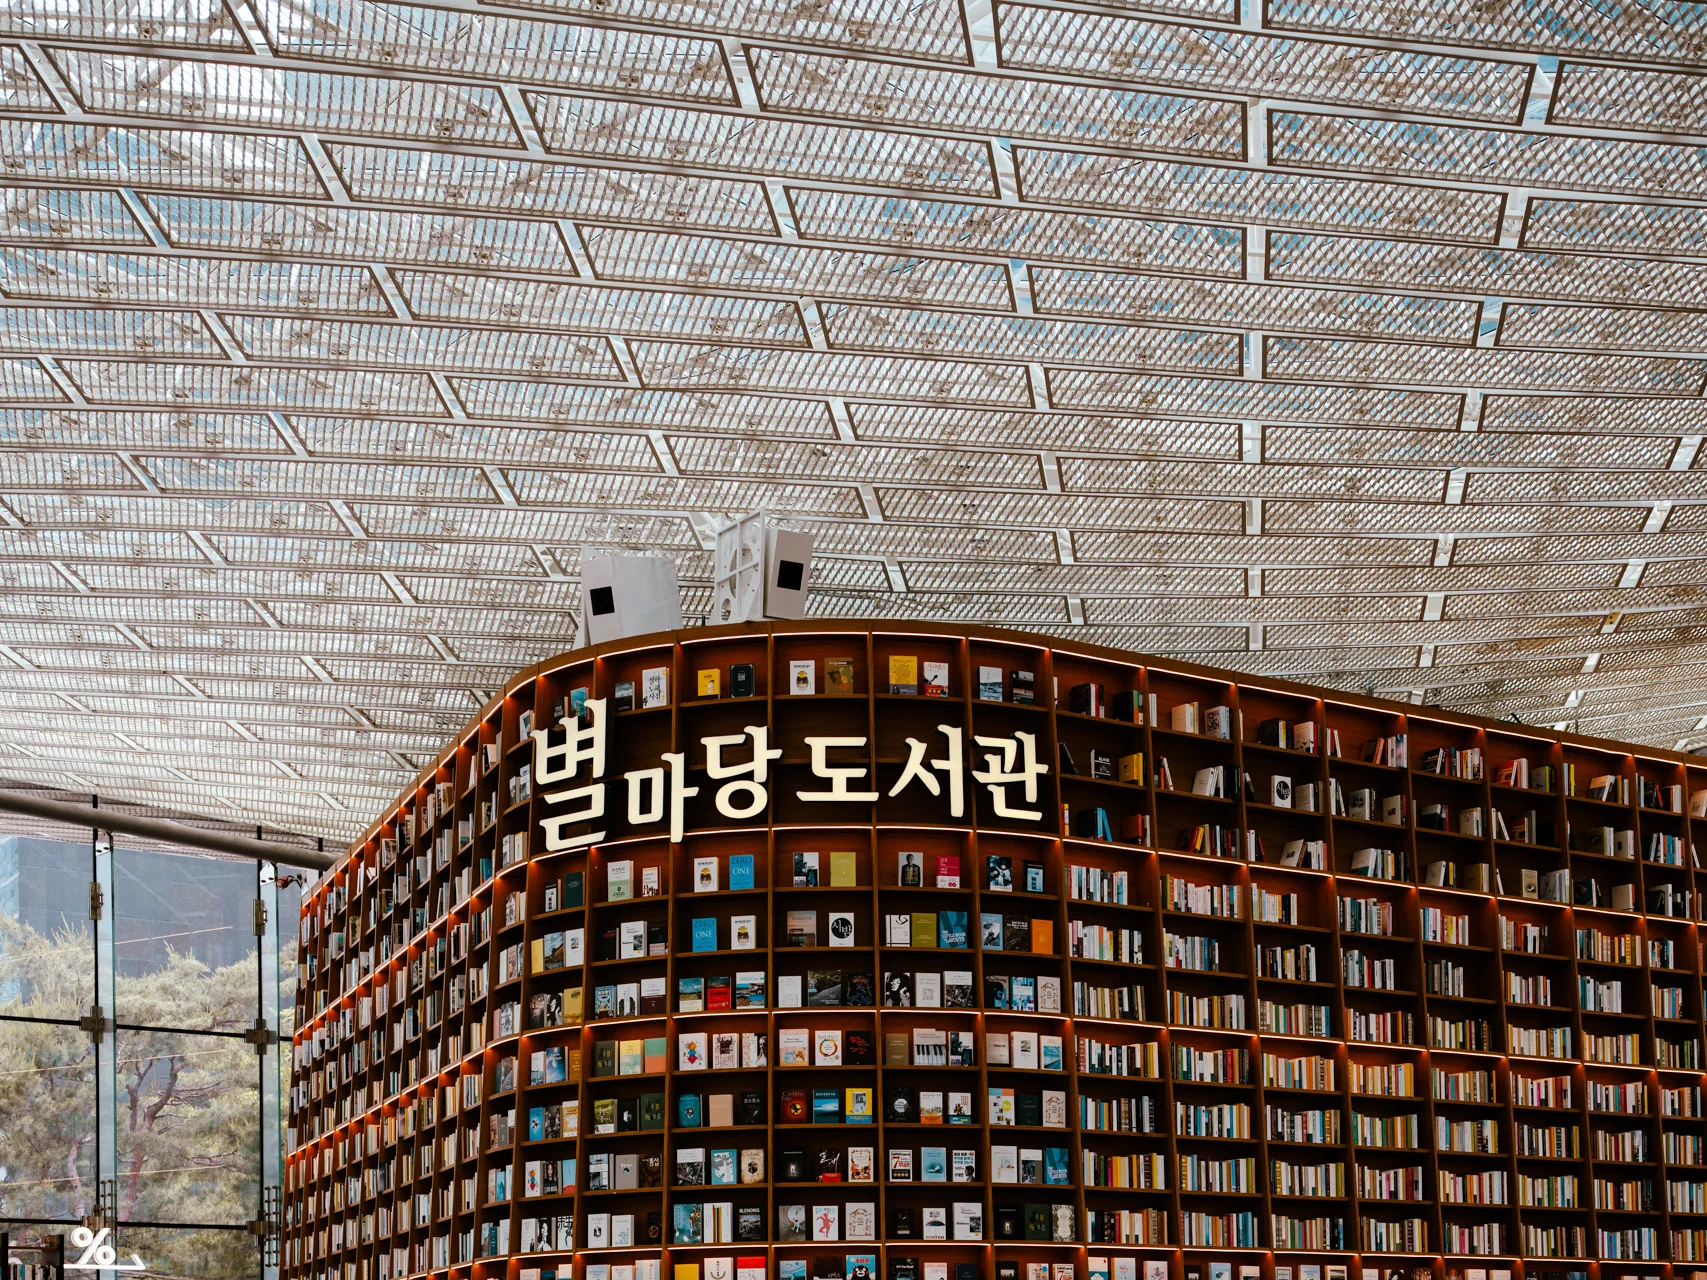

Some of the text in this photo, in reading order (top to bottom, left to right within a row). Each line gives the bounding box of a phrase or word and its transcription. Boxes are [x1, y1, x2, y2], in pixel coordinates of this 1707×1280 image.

[530, 697, 1049, 851] 별마당 도서관
[731, 856, 752, 864] ZERO
[733, 867, 750, 875] ONE
[695, 931, 713, 939] ONE
